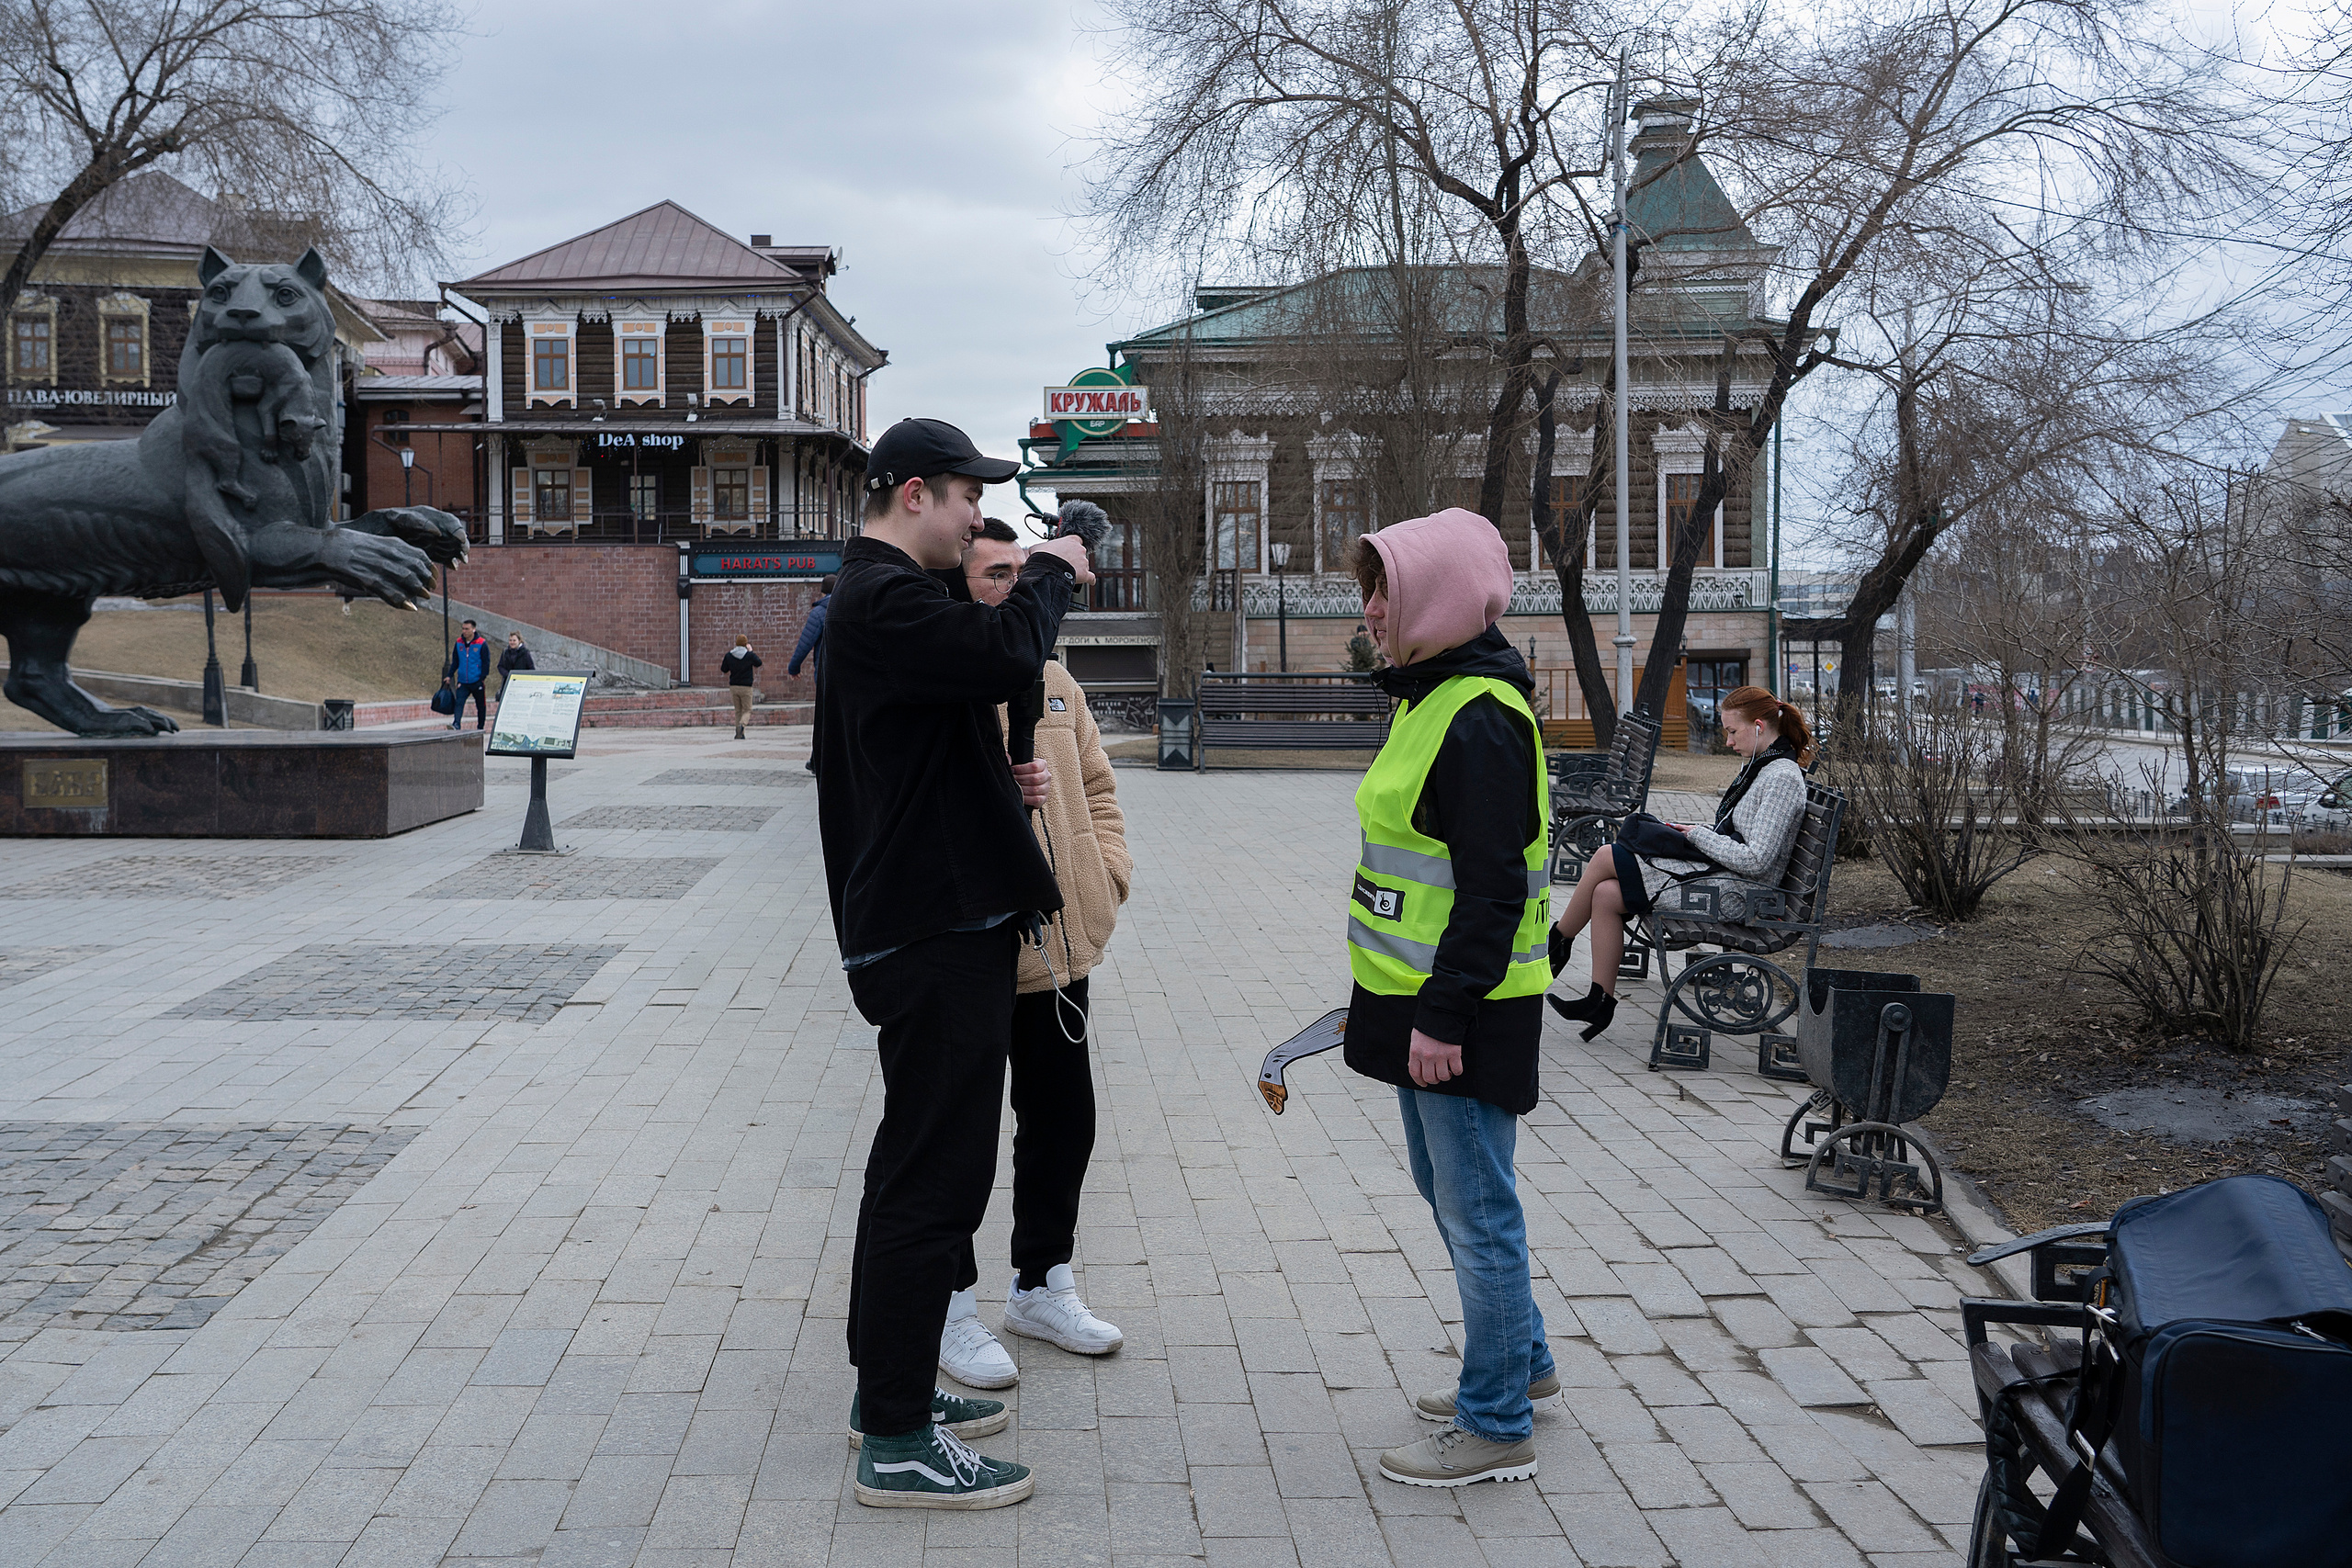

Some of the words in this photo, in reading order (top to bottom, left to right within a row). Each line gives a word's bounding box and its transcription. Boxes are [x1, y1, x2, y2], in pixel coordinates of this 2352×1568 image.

[1051, 393, 1141, 412] КРУЖАЛЬ
[1090, 420, 1105, 428] БАР
[598, 434, 635, 446] DeA
[642, 434, 684, 450] shop
[720, 558, 781, 570] HARAT'S
[787, 558, 816, 569] PUB
